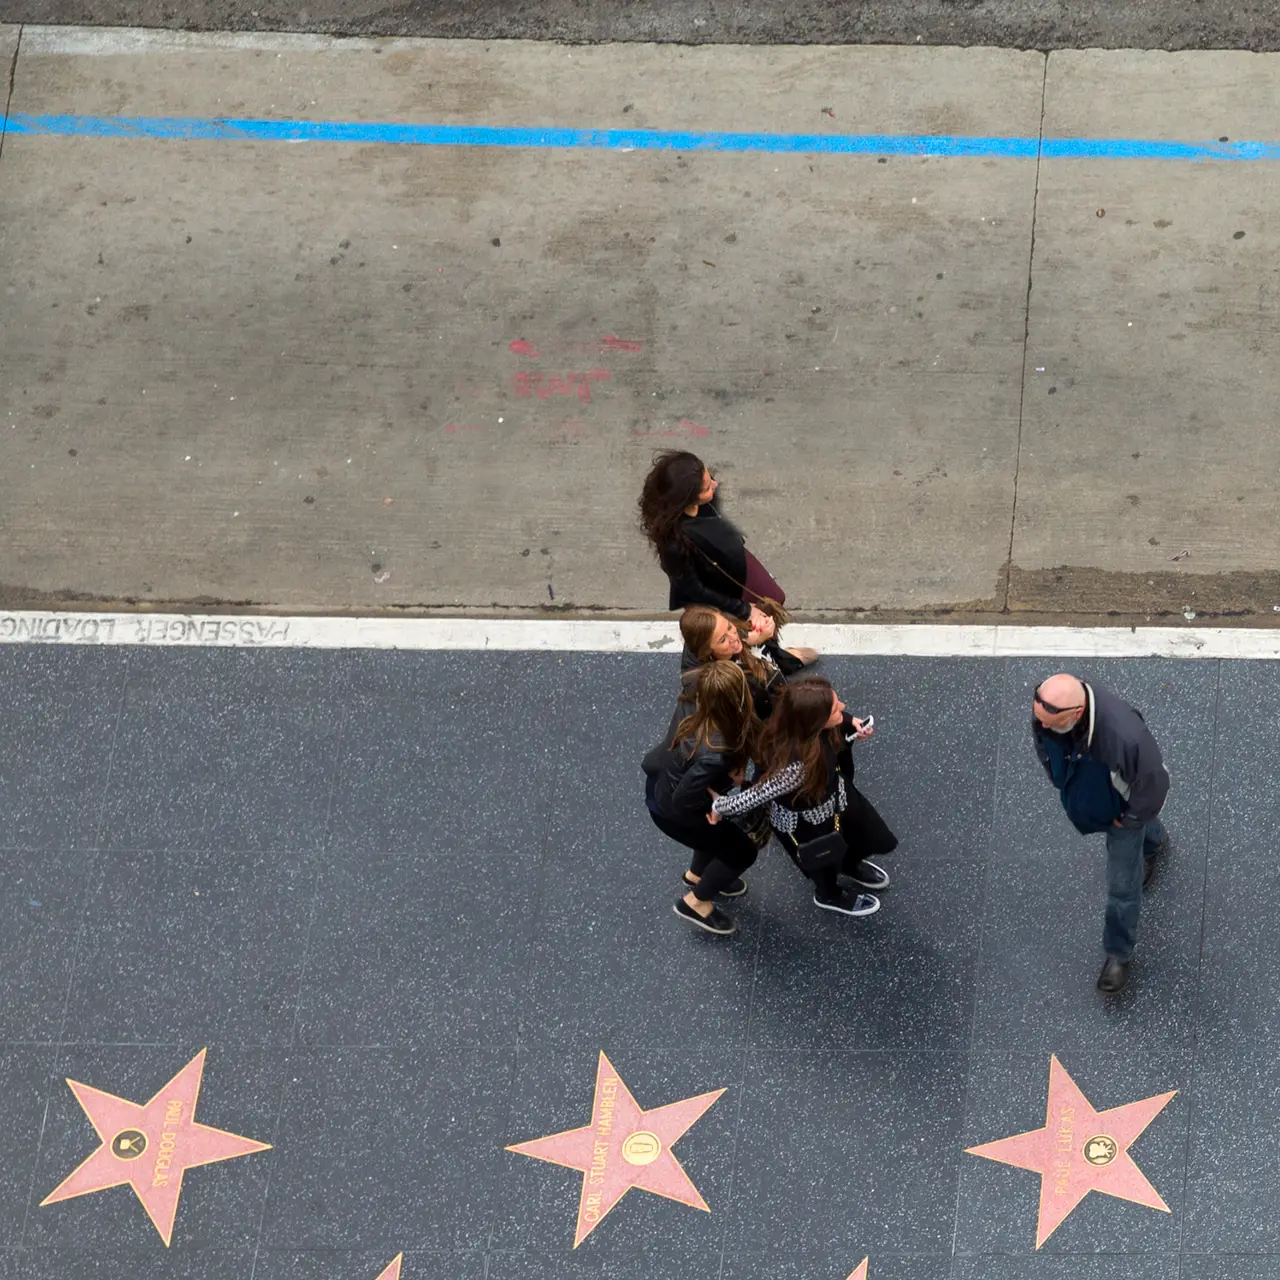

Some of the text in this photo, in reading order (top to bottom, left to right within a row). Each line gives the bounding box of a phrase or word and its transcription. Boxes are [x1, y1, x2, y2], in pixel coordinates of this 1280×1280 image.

[0, 617, 292, 645] PASSENGER LOADING
[152, 1100, 183, 1187] PAUL DOUGLAS
[584, 1077, 618, 1222] CARL STUART HAMBLEN
[1055, 1108, 1075, 1195] PAUL LUKAS
